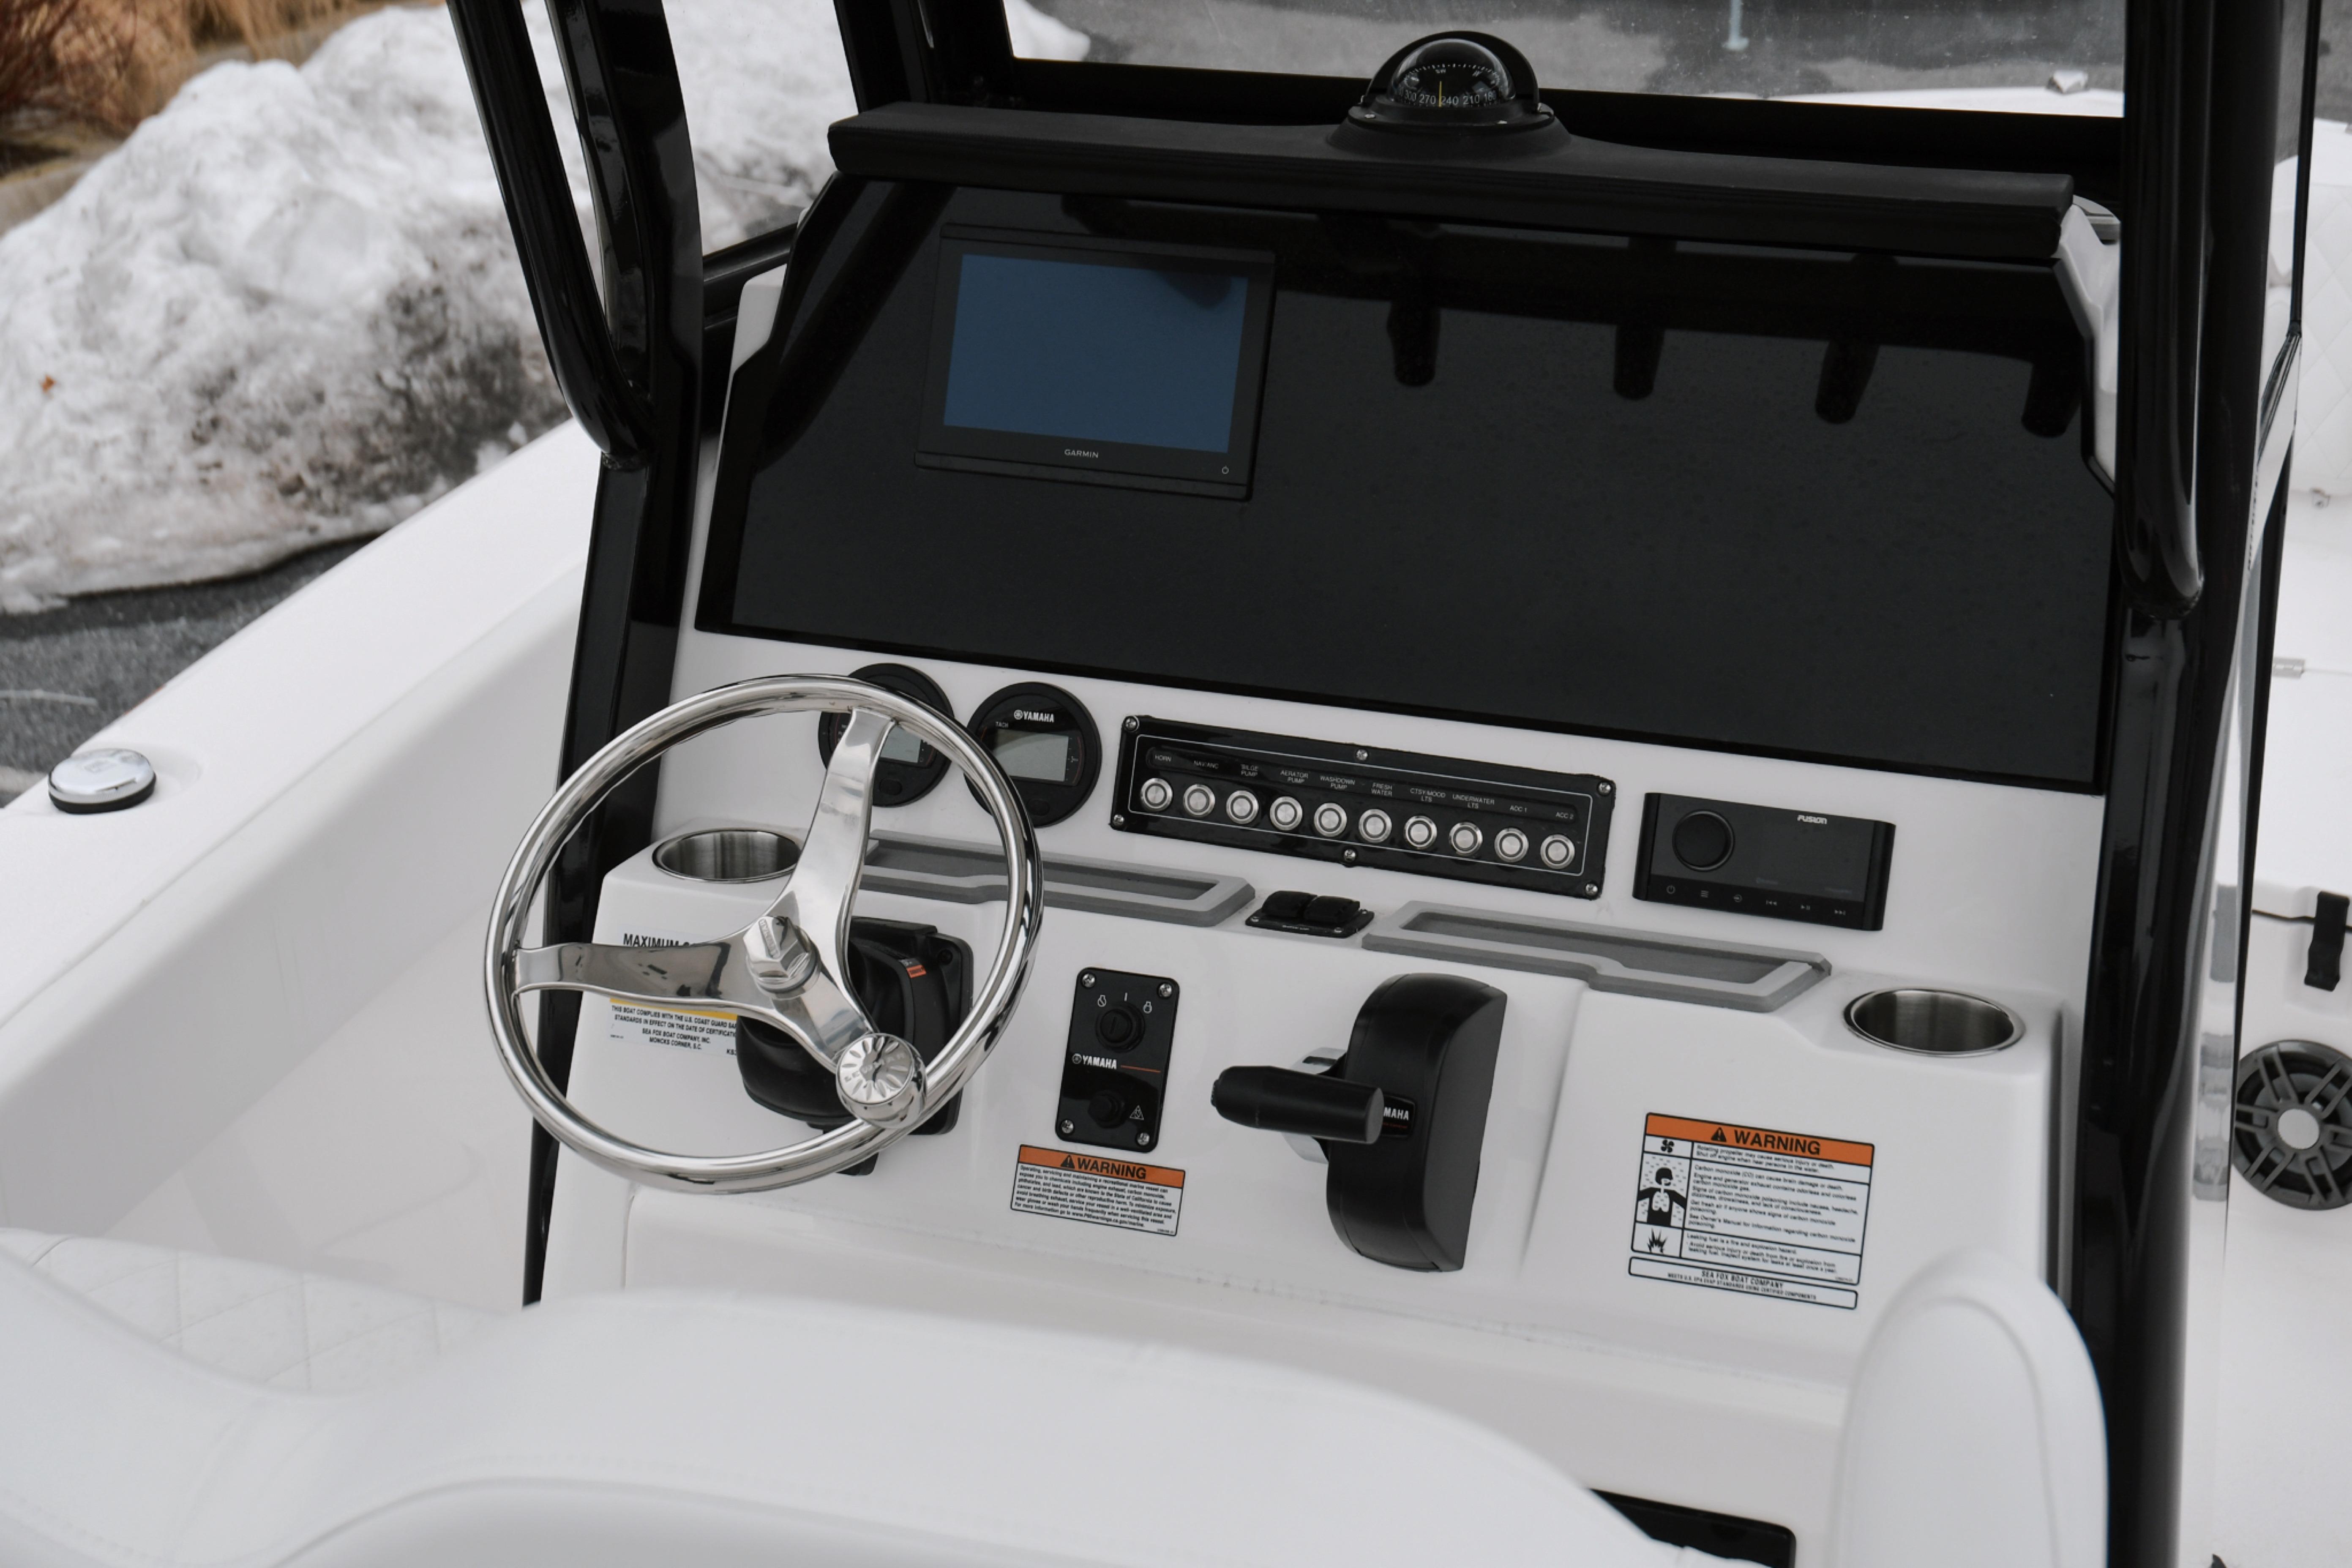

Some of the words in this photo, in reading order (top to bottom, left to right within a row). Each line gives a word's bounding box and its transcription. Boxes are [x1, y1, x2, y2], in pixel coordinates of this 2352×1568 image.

[1419, 93, 1436, 104] 270
[1441, 95, 1459, 105] 240
[1463, 95, 1480, 104] 210
[1064, 449, 1099, 458] GARMIN
[1023, 711, 1055, 723] YAMAHA
[1280, 769, 1308, 779] AERATOR
[1320, 775, 1355, 785] WASHDOWN
[1371, 788, 1392, 796] WATER
[1373, 783, 1392, 791] FRESH
[1452, 794, 1495, 804] UNDERWATER
[615, 1014, 642, 1024] STANDARDS
[649, 1019, 666, 1027] EFFECT
[685, 1024, 697, 1032] DATE
[637, 1009, 660, 1018] COMPLIES
[694, 1017, 710, 1025] COAST
[649, 1036, 670, 1045] MONCKS
[1083, 1054, 1117, 1069] YAMAHA
[1734, 1129, 1821, 1156] WARNING
[1078, 1157, 1147, 1180] WARNING
[1702, 1270, 1714, 1278] SEA
[1716, 1272, 1728, 1280] FOX
[1731, 1274, 1748, 1283] BOAT
[1751, 1277, 1783, 1288] COMPANY
